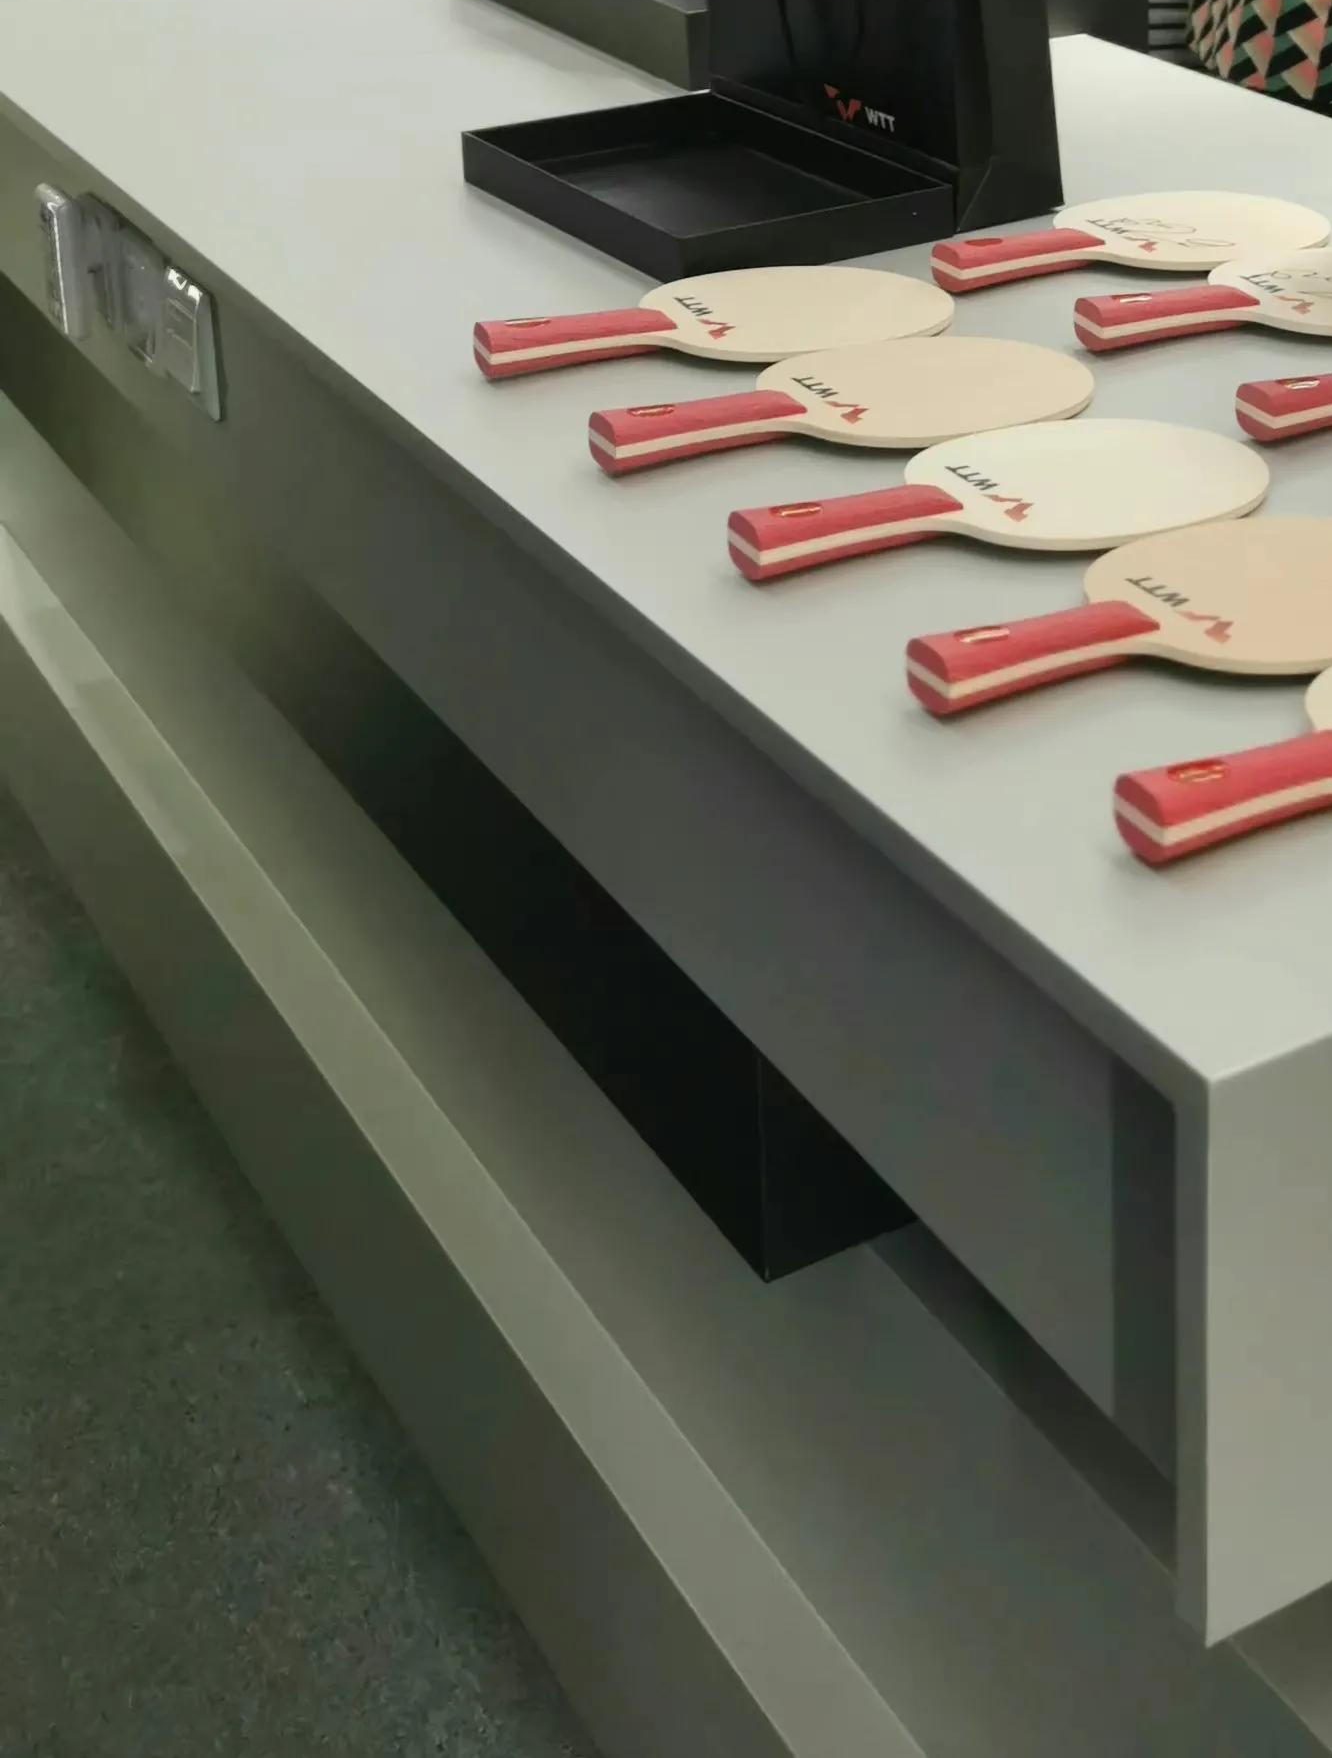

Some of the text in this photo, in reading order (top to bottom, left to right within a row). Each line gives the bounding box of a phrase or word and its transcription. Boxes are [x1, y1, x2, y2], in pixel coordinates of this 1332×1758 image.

[865, 106, 896, 133] WTT
[673, 297, 713, 317] WTT
[791, 376, 839, 399] WTT
[944, 465, 999, 491] WTT
[1124, 575, 1190, 607] WTT
